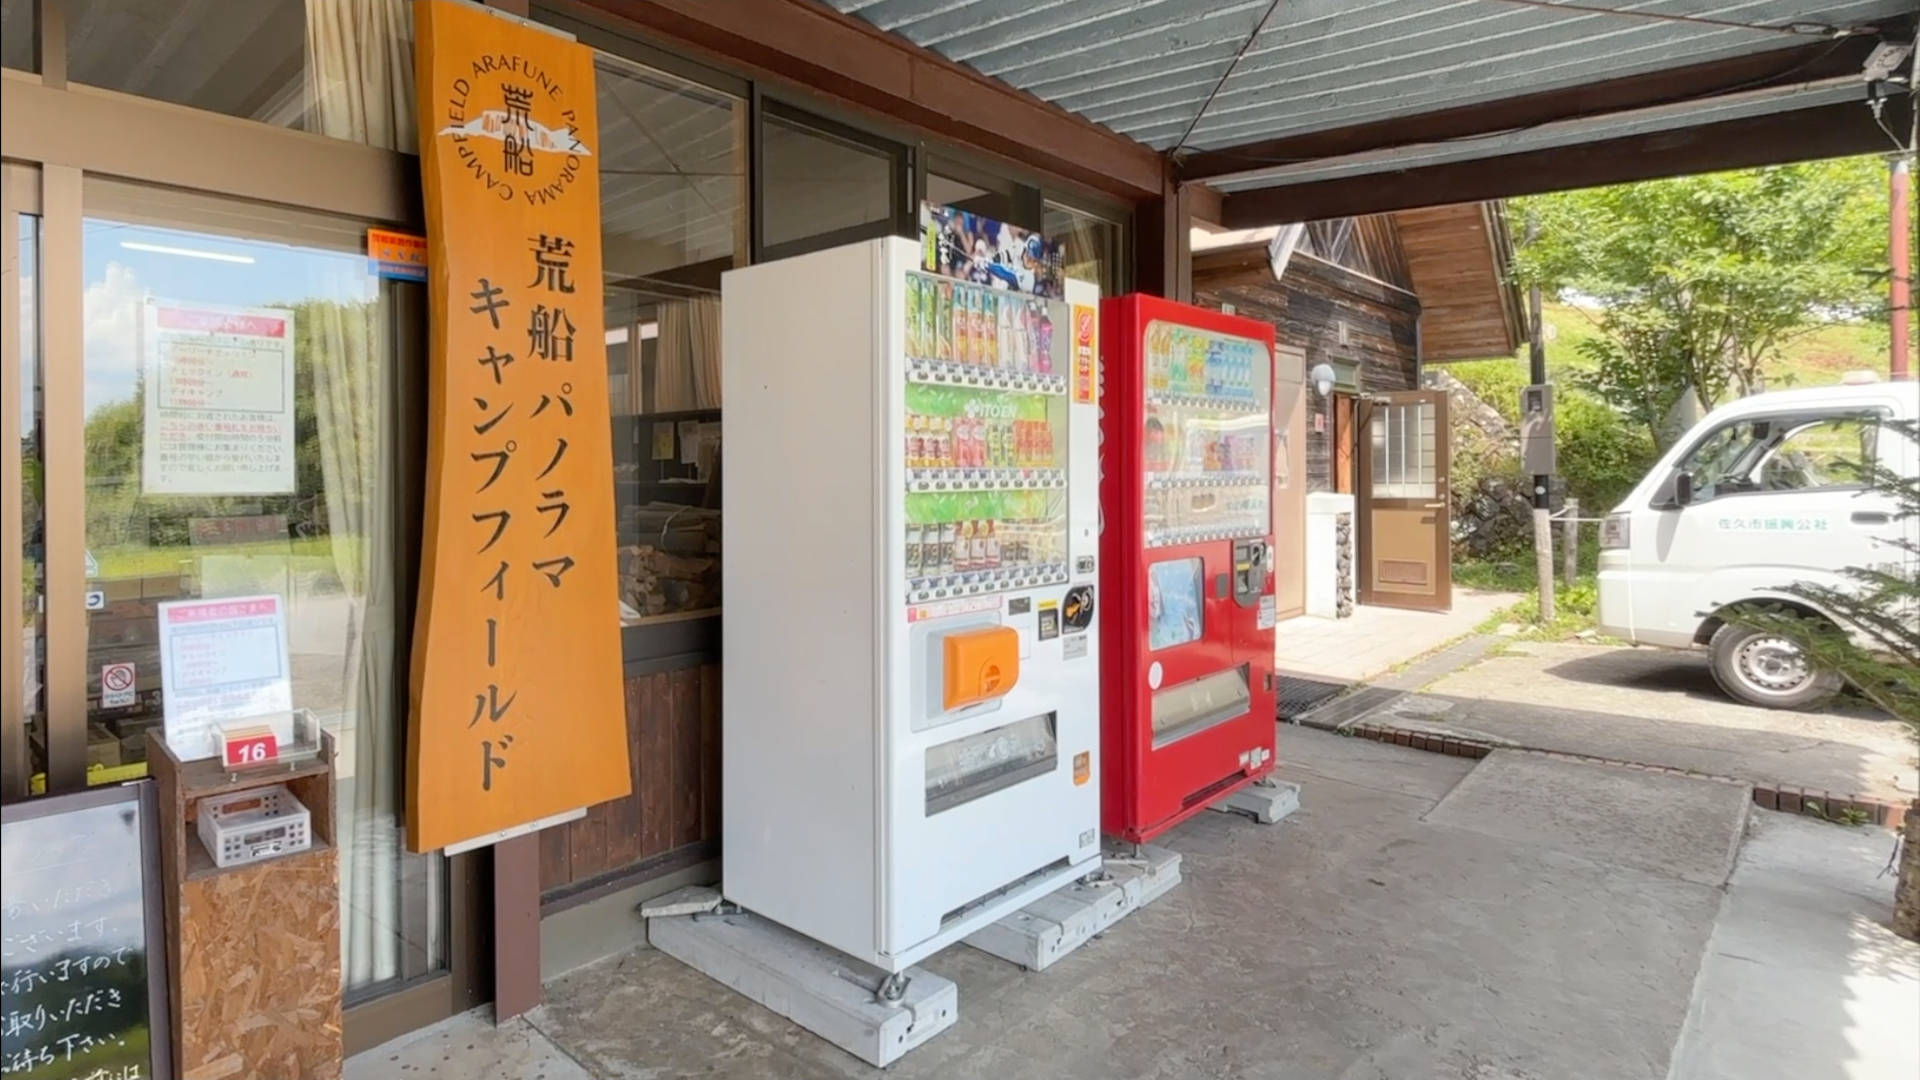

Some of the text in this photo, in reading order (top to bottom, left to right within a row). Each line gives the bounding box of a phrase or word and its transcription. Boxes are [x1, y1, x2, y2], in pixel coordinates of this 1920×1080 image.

[472, 54, 563, 102] ARAFUNE
[450, 78, 514, 201] CAMPFIELD
[524, 109, 580, 206] PANORAMA
[527, 233, 576, 588] 荒船パノラマ
[468, 278, 518, 792] キャンプフィールド
[238, 742, 267, 764] 16
